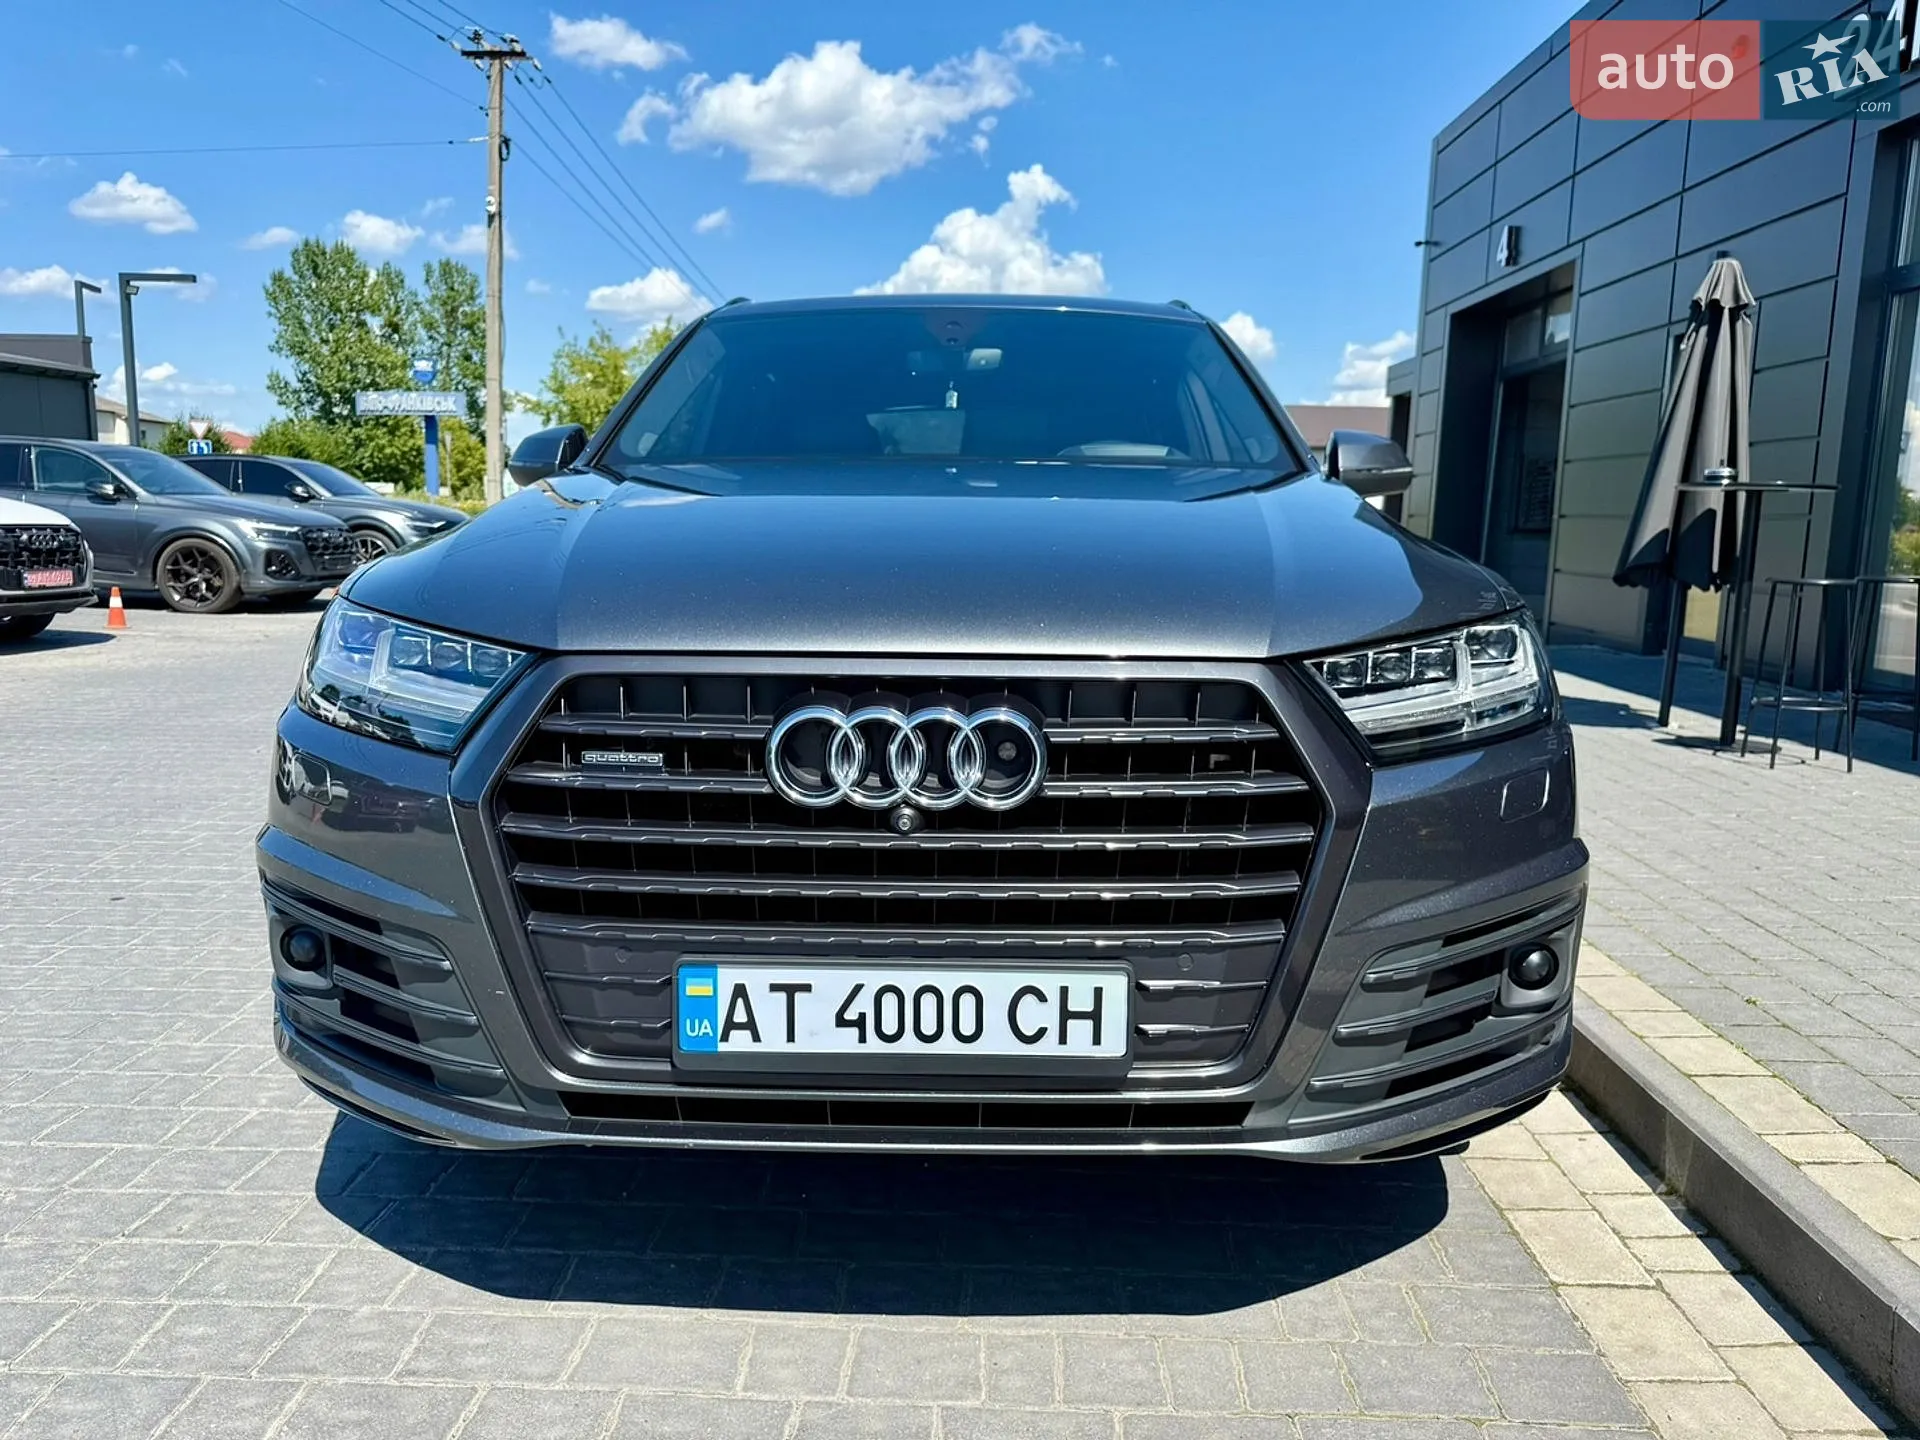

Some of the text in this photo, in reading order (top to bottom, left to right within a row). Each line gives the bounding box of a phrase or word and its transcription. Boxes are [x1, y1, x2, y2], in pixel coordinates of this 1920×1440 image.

[585, 754, 659, 763] quattro
[719, 983, 1102, 1045] AT 4000 CH
[686, 1019, 713, 1037] UA
